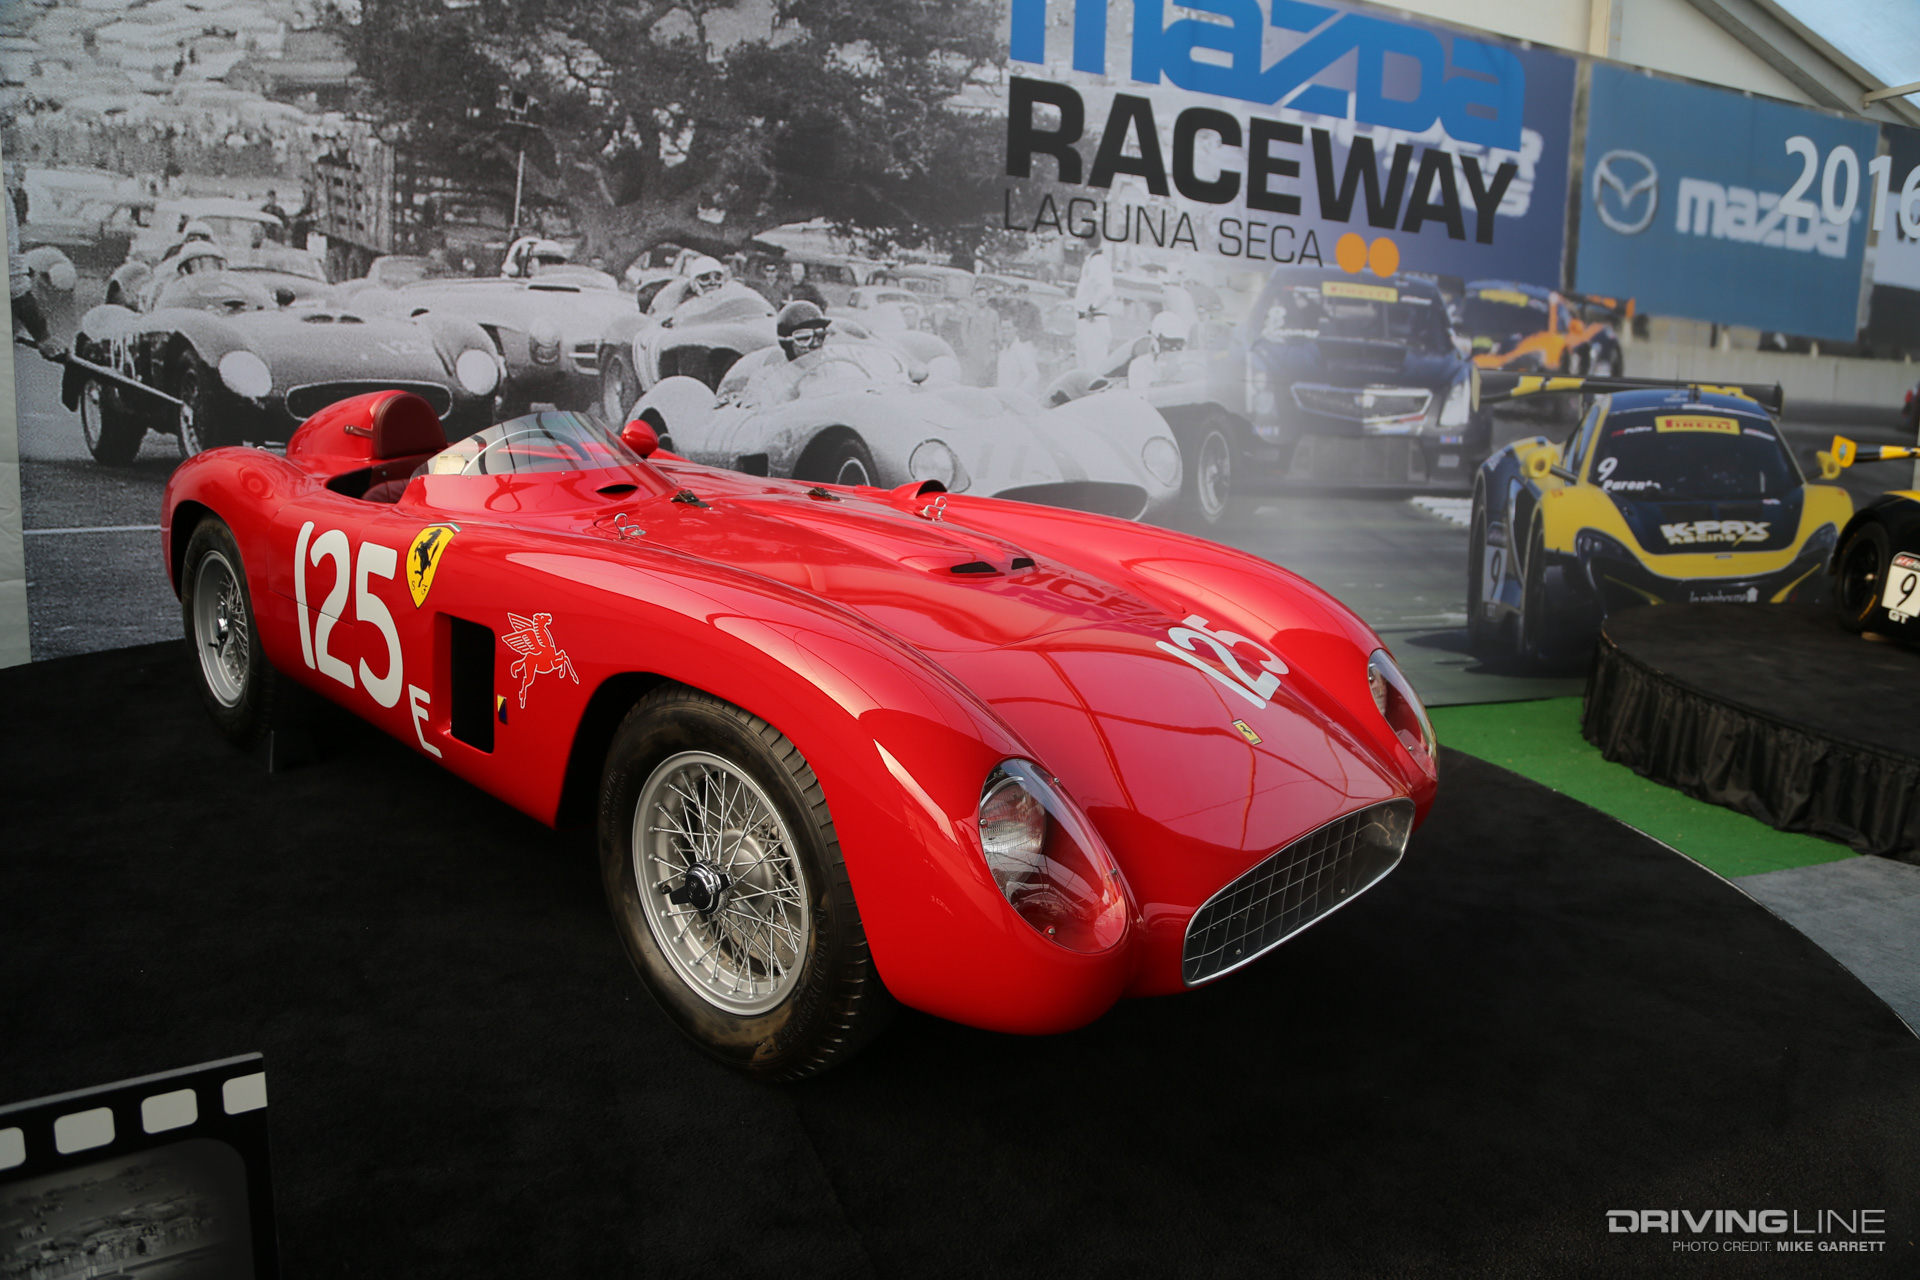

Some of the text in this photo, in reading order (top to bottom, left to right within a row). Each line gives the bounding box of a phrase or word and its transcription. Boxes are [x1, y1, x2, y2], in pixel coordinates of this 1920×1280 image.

[1006, 75, 1519, 245] RACEWAY
[1004, 188, 1323, 268] LAGUNA SECA
[1665, 418, 1732, 431] PIRELLI
[1597, 456, 1618, 481] 9
[1660, 520, 1771, 541] K-PAX
[294, 521, 403, 708] 125
[1888, 609, 1909, 624] GT
[1896, 572, 1917, 608] 9
[1156, 614, 1290, 709] 125
[408, 684, 442, 758] E
